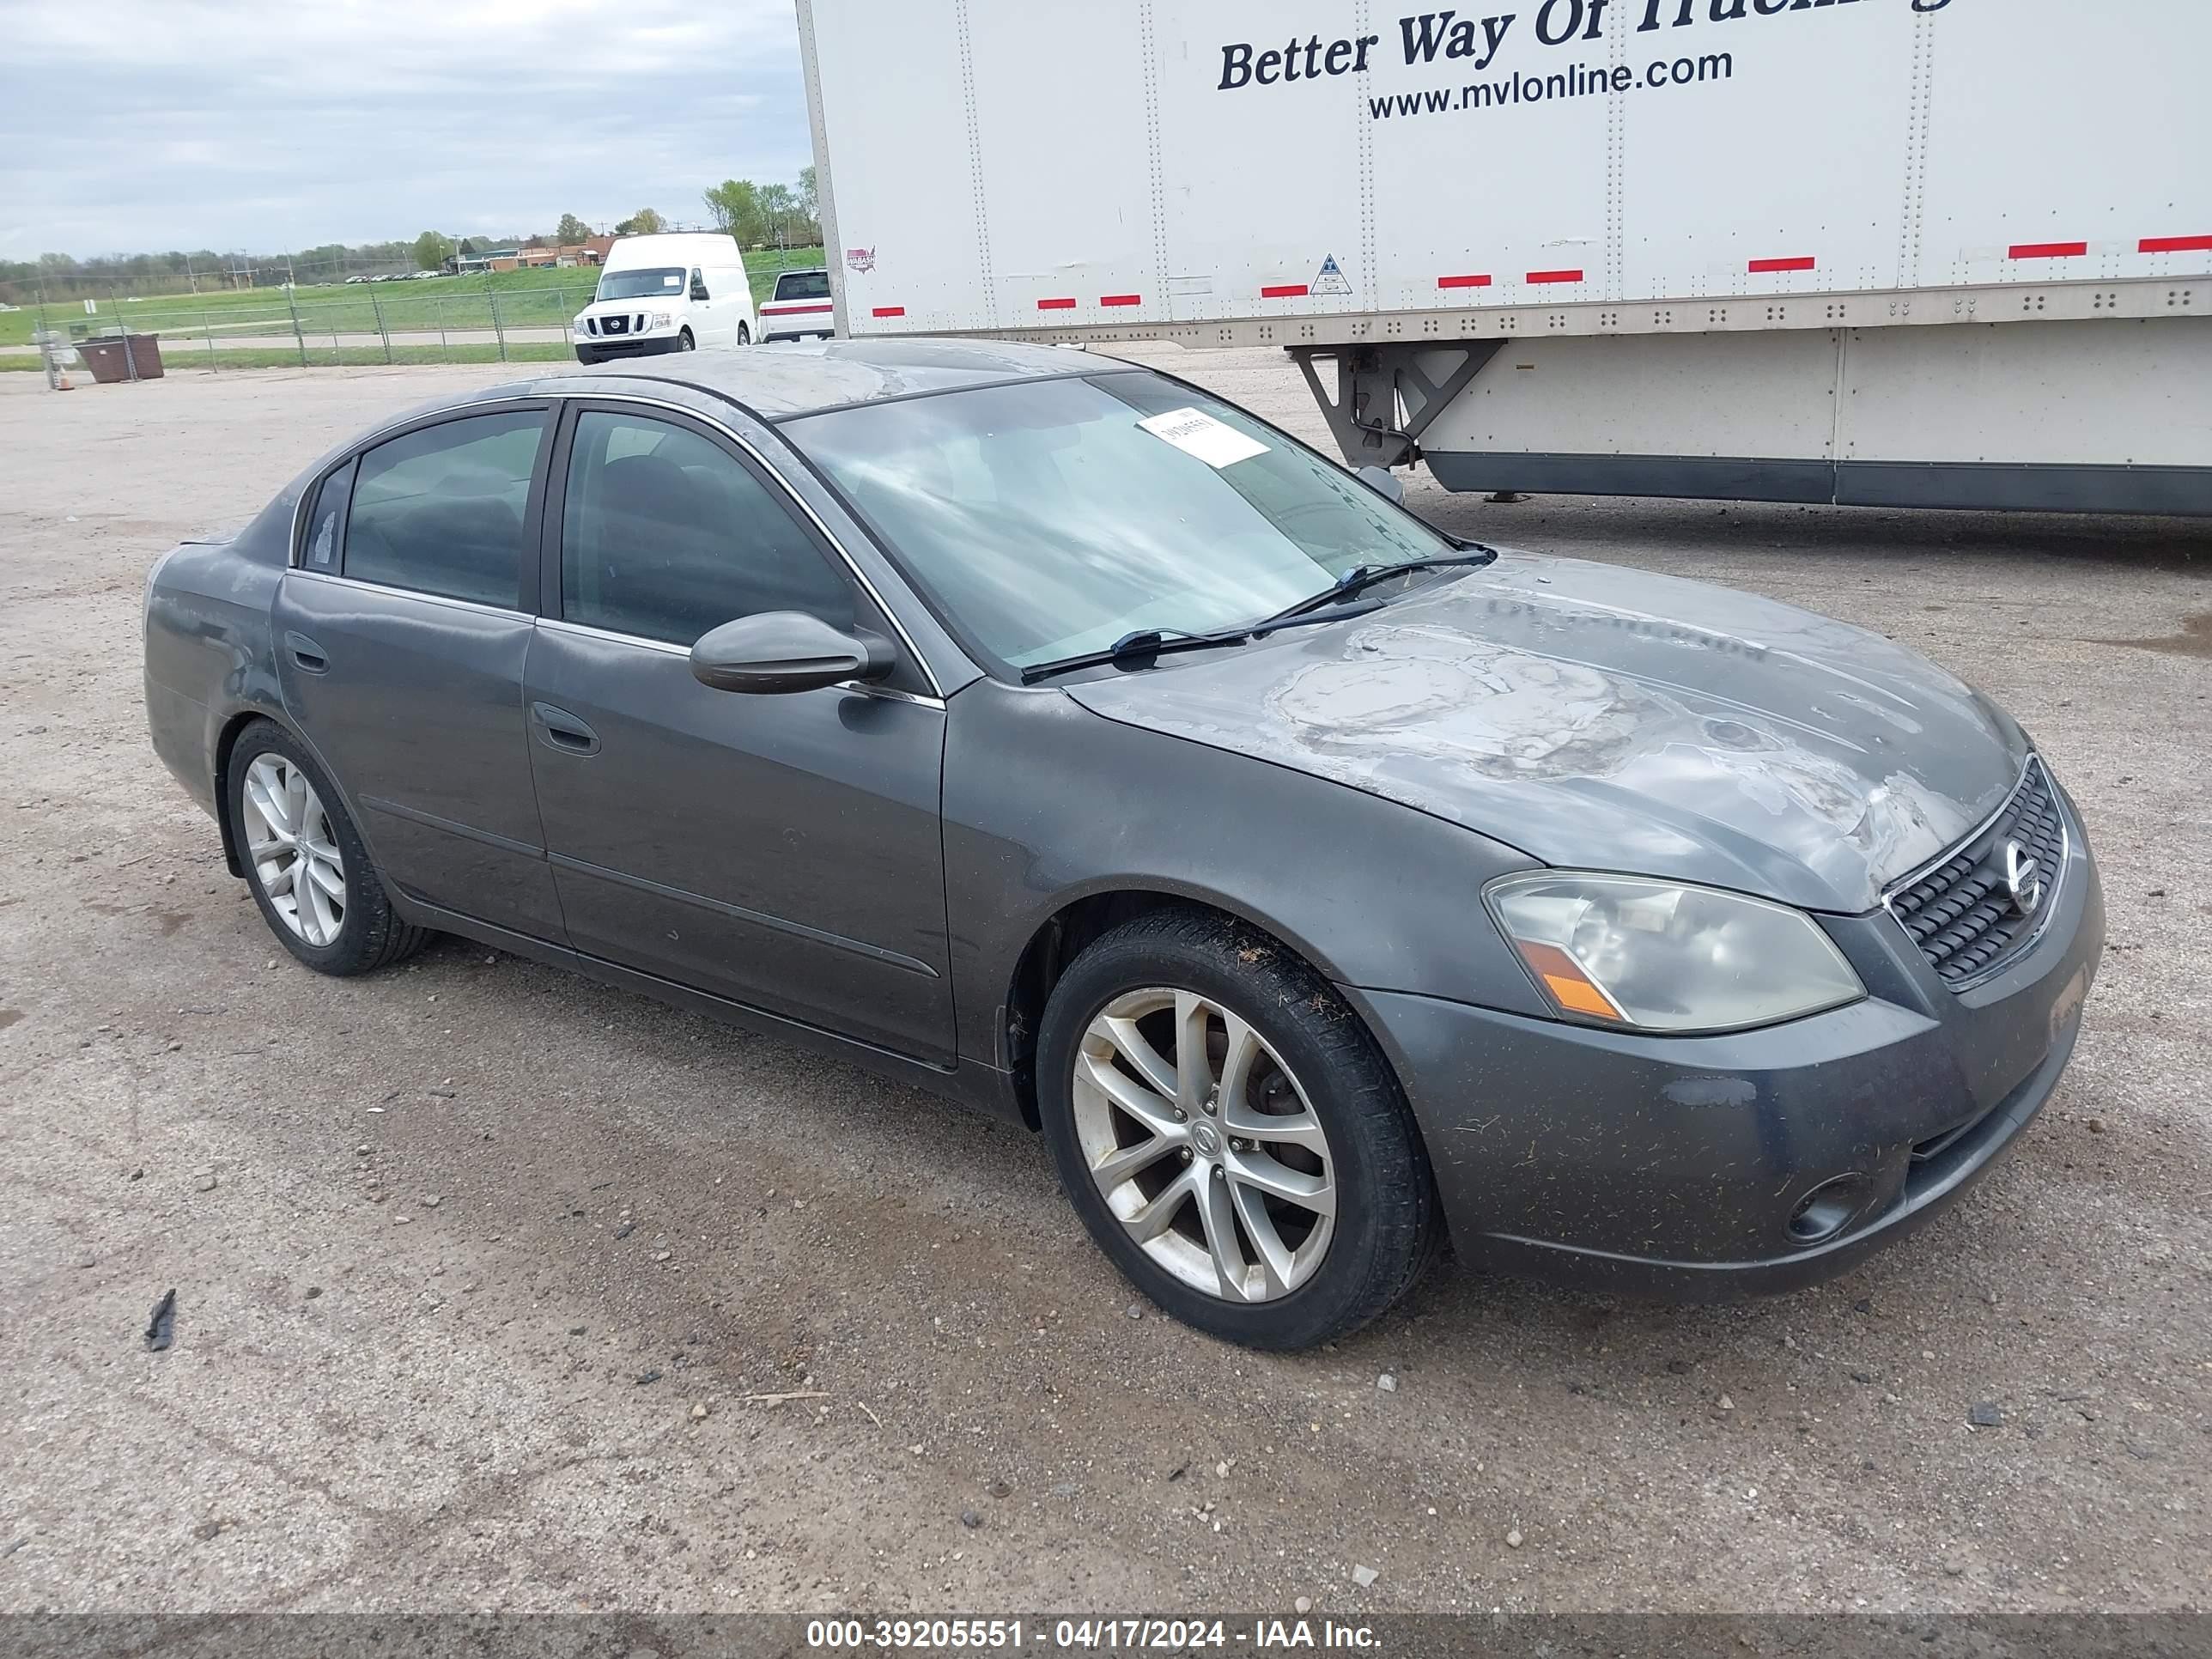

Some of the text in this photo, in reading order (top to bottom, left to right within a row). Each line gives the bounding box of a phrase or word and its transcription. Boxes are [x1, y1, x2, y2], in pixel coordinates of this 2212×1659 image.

[1217, 34, 1379, 90] Better
[1399, 10, 1516, 70] Way
[1535, 0, 1609, 46] Of
[1369, 52, 1732, 120] www.mvlonline.com
[847, 256, 875, 266] WABASH
